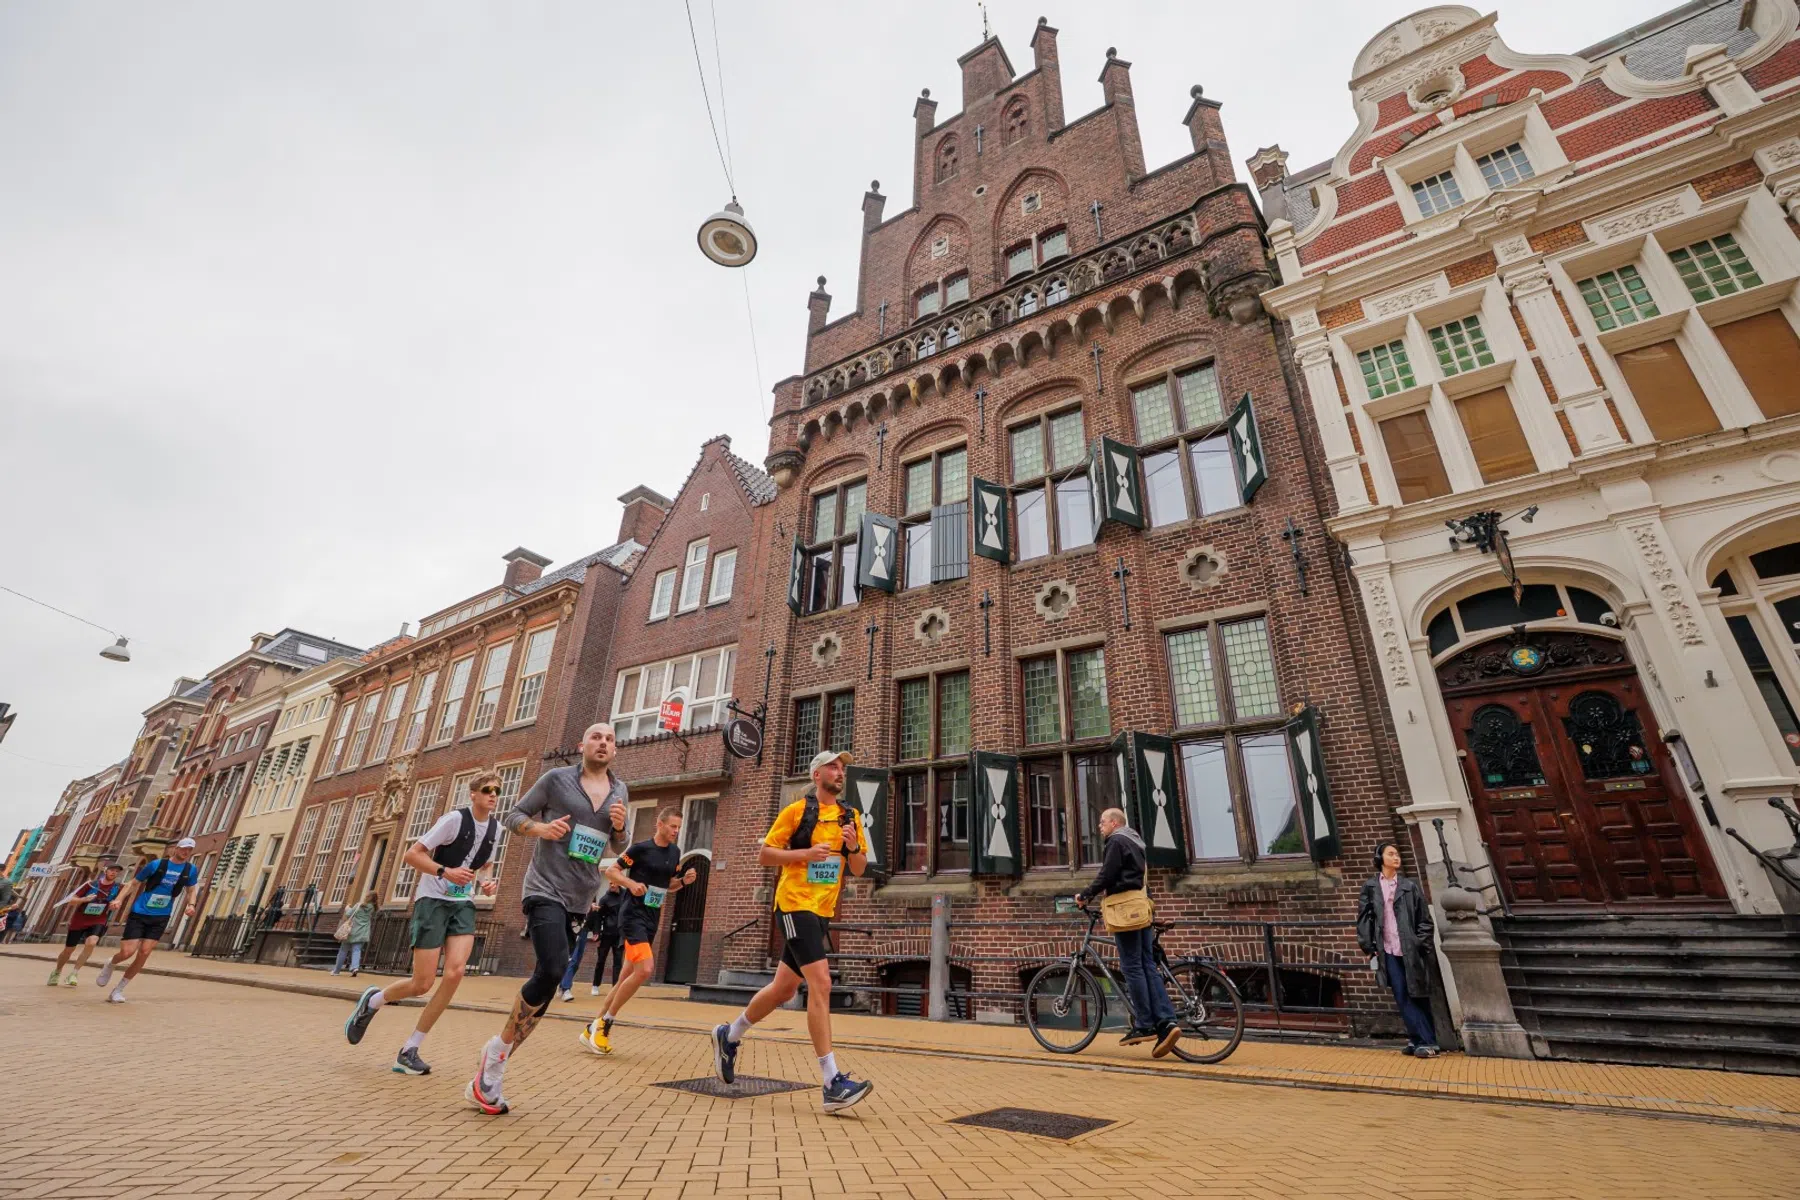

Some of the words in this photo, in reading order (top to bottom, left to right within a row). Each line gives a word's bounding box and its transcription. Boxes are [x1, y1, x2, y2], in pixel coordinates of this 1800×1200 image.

[662, 708, 680, 717] HUUR
[576, 833, 605, 848] THOMAS
[578, 843, 599, 857] 1574
